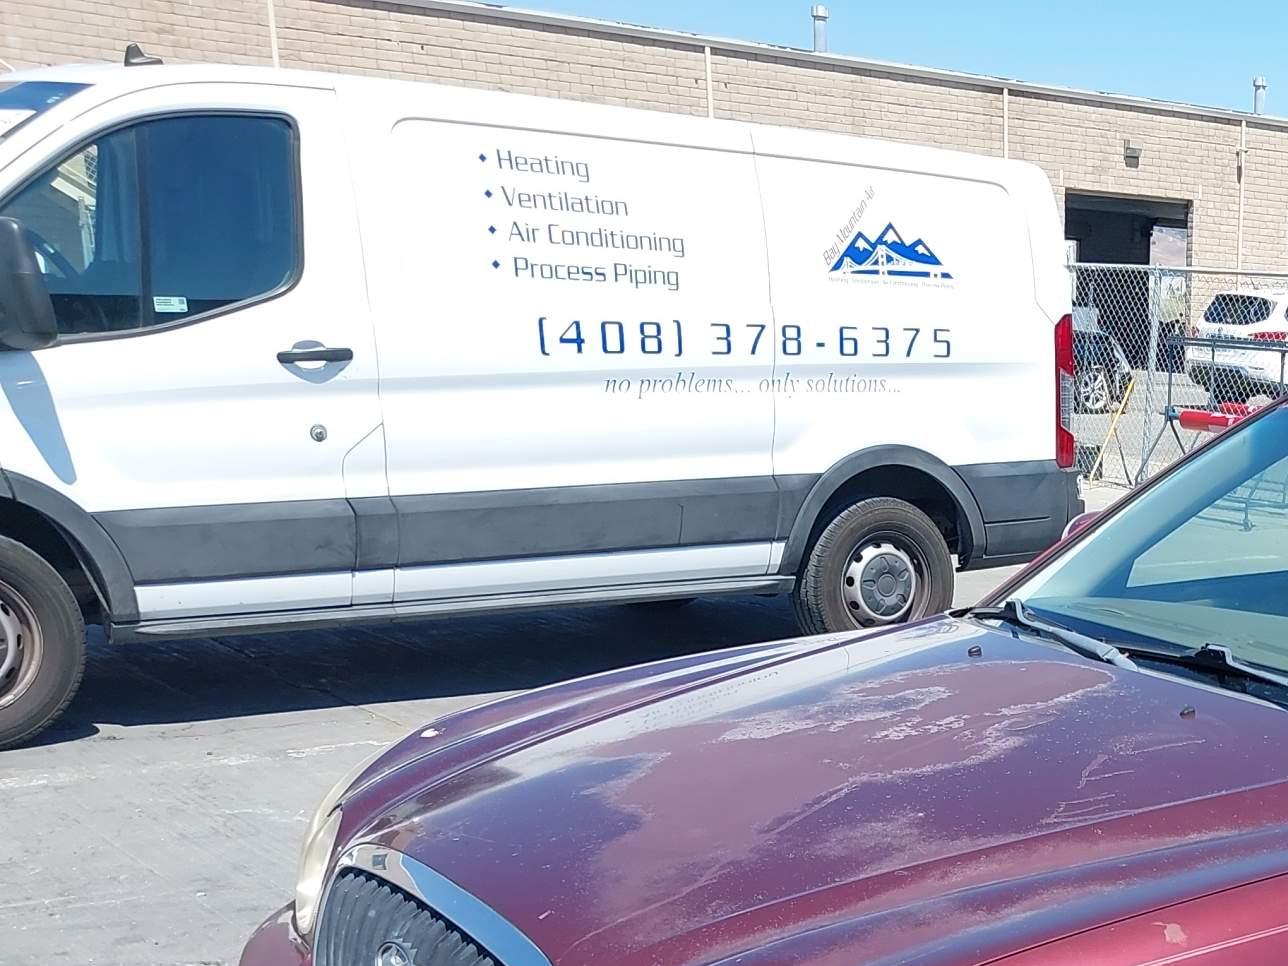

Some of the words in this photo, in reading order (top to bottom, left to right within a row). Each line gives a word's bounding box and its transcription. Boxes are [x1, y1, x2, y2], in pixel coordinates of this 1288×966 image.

[496, 148, 590, 183] Heating
[501, 186, 629, 216] Ventilation
[509, 221, 540, 243] Air
[548, 223, 685, 258] Conditioning
[822, 244, 840, 266] Bay
[837, 199, 867, 243] Mountain
[865, 185, 876, 200] Air
[513, 256, 607, 282] Process
[614, 262, 680, 291] Piping
[538, 317, 683, 357] (408)
[710, 322, 952, 358] 378-6375
[604, 378, 632, 394] no
[637, 372, 751, 400] problems...
[759, 372, 800, 398] only
[806, 372, 901, 393] solutions...
